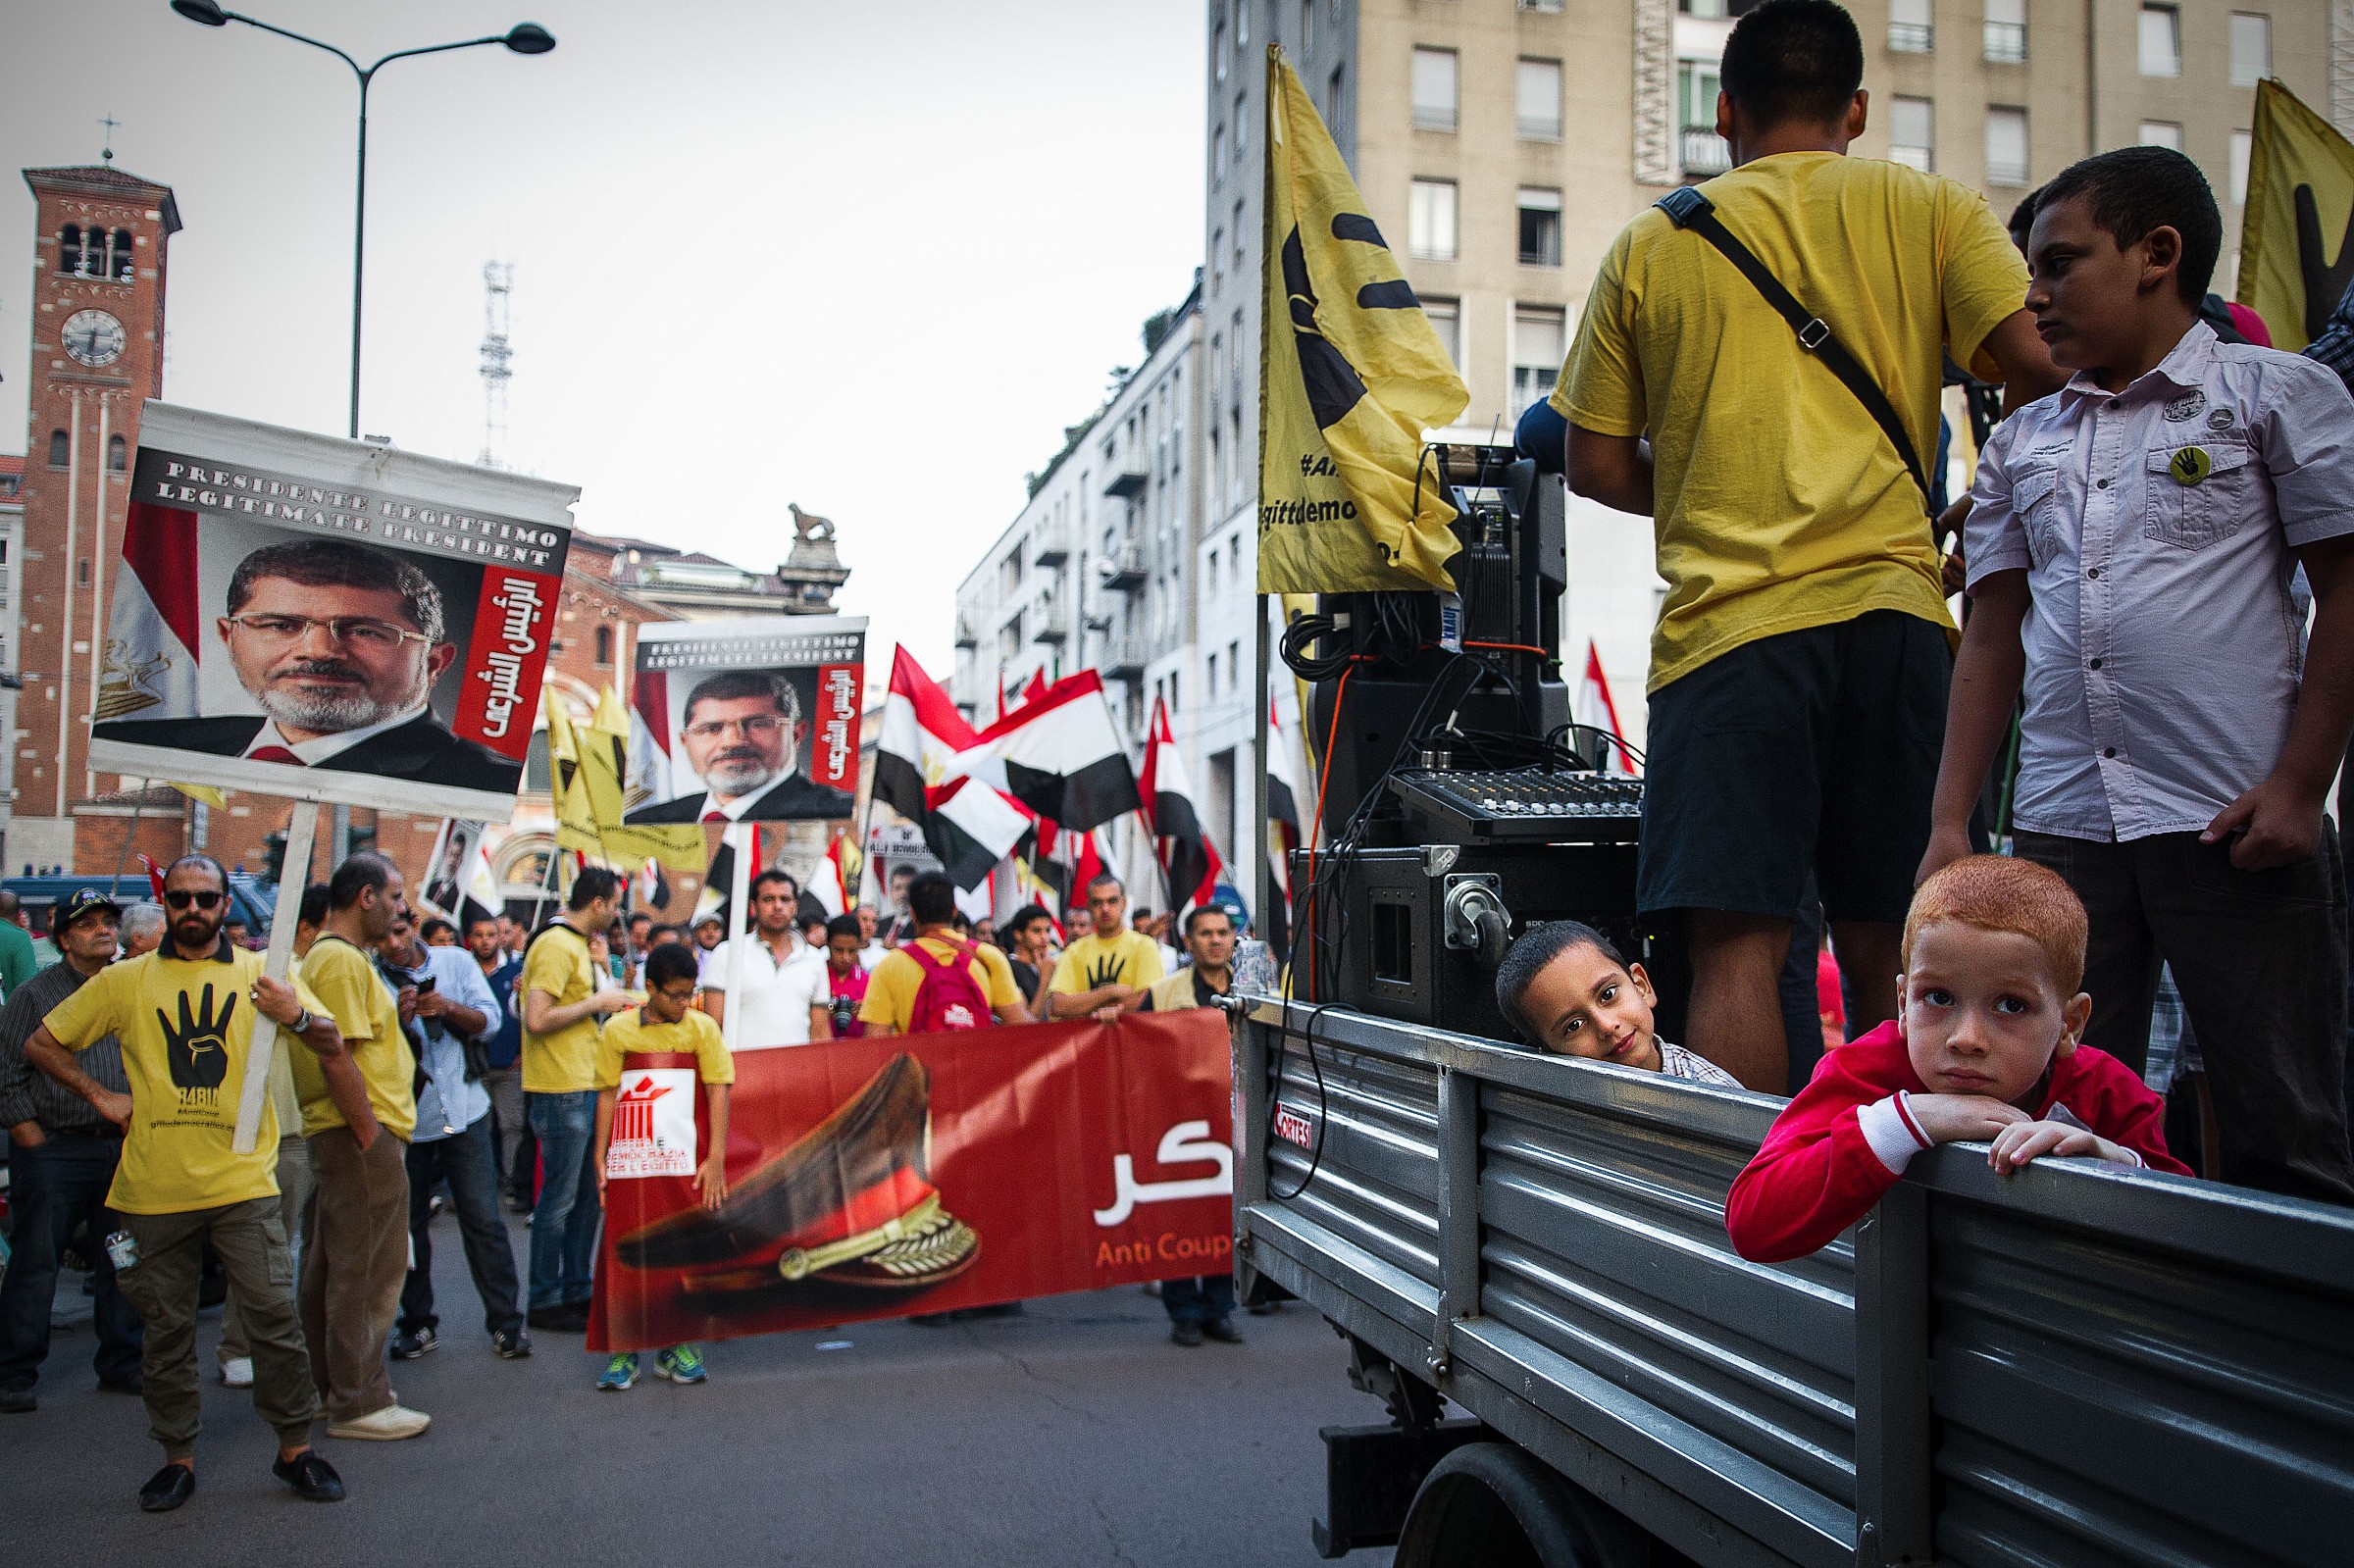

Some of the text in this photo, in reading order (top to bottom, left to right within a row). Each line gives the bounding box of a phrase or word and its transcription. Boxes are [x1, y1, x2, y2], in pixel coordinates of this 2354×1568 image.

[155, 481, 551, 567] LEGITIMATE PRESIDENT
[166, 461, 559, 548] PRESIDENTE LEGITTIMO
[1096, 1232, 1232, 1268] Anti Coup
